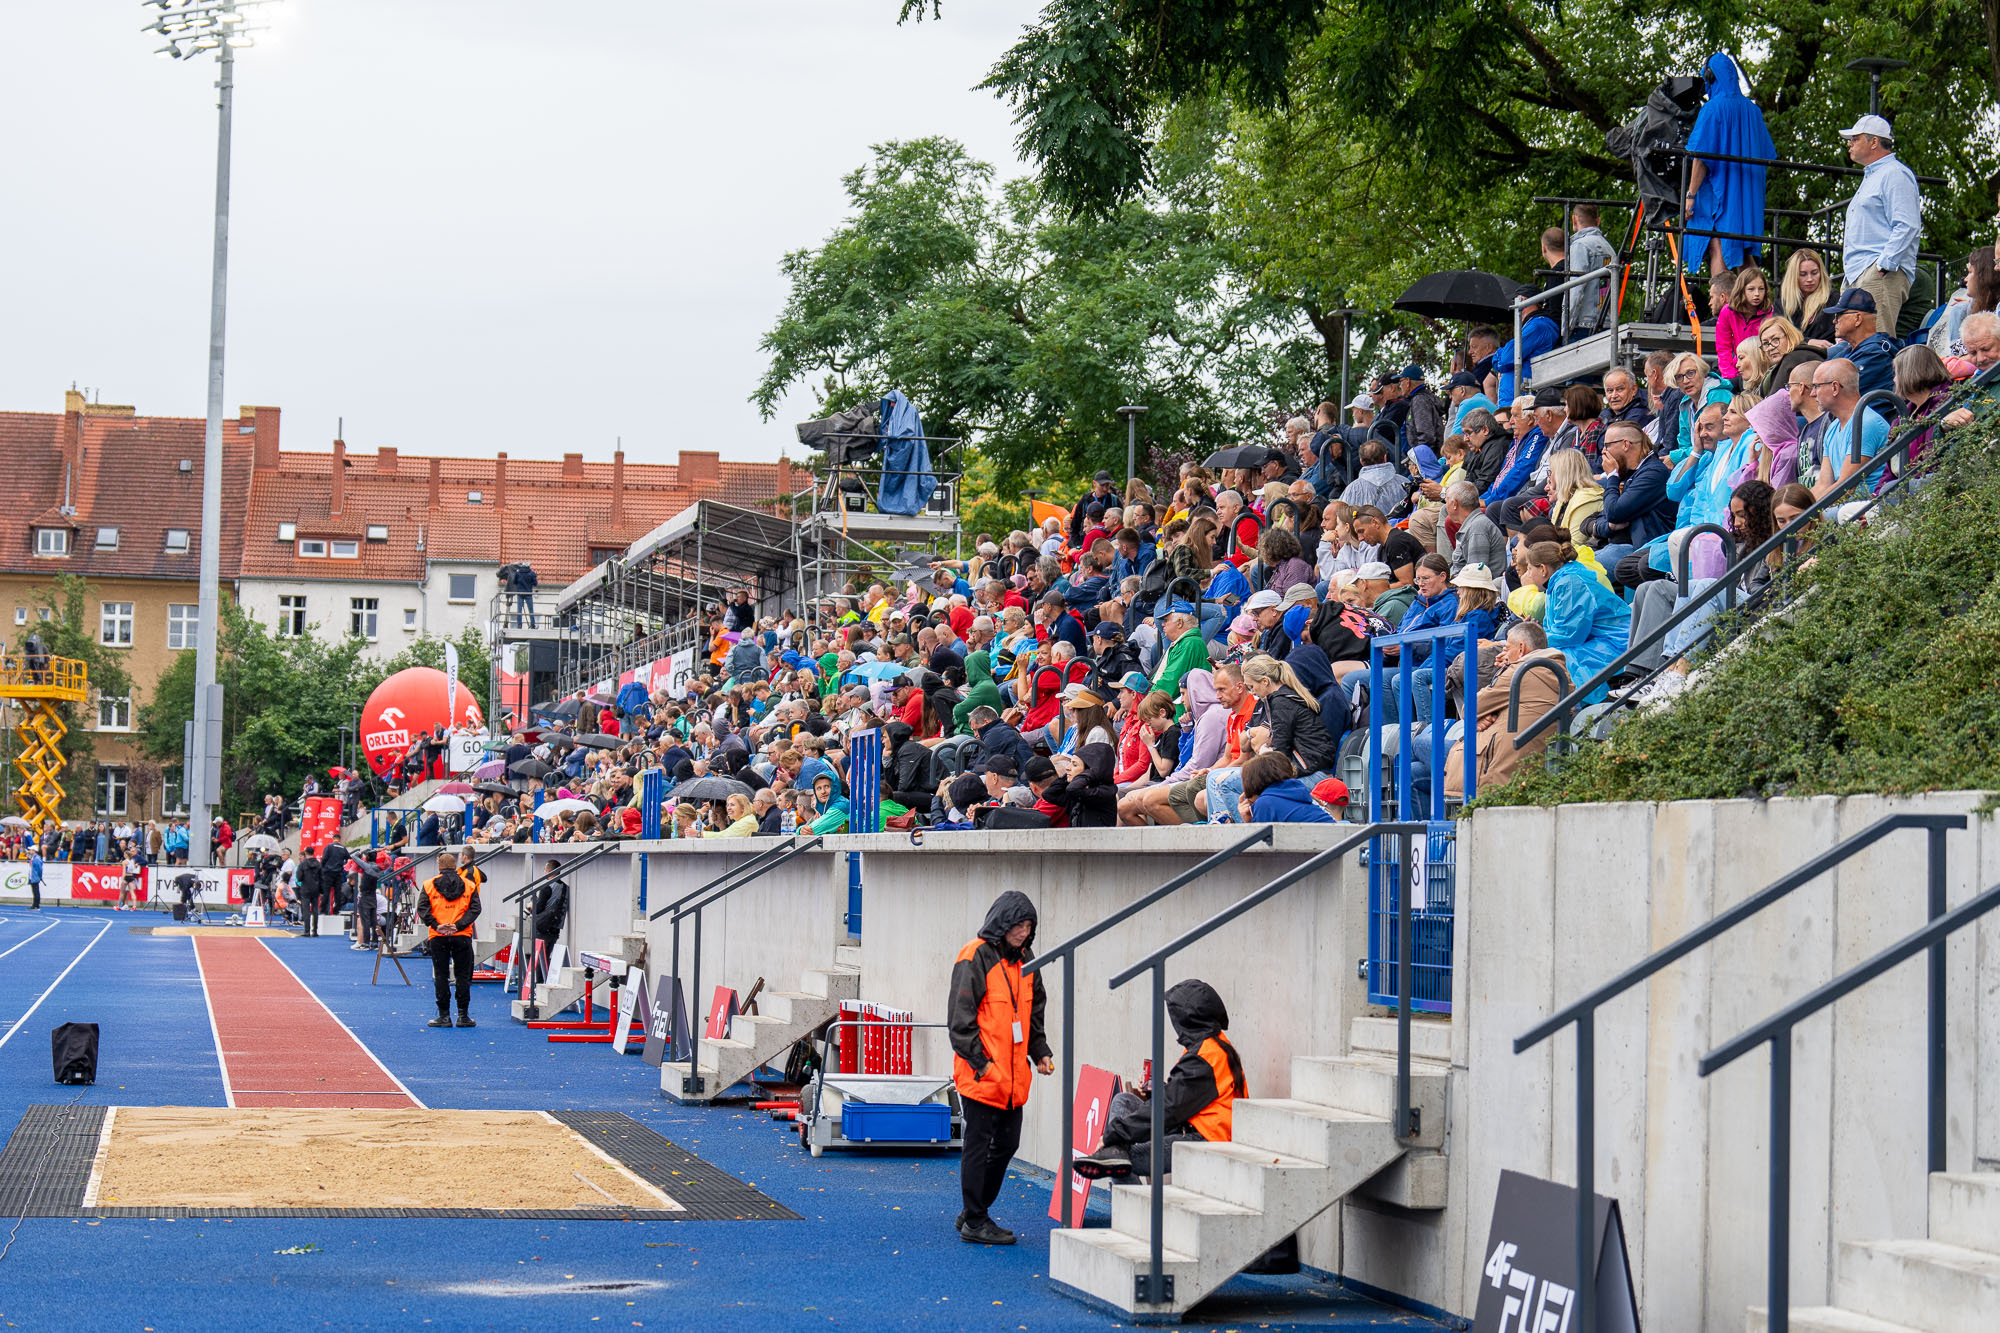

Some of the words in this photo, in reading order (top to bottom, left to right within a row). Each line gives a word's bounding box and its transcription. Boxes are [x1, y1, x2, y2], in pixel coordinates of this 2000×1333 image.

[368, 734, 405, 748] ORLEN
[1411, 847, 1420, 886] 8
[101, 875, 142, 890] ORN
[252, 911, 258, 921] 1
[1485, 1240, 1518, 1289] 4F
